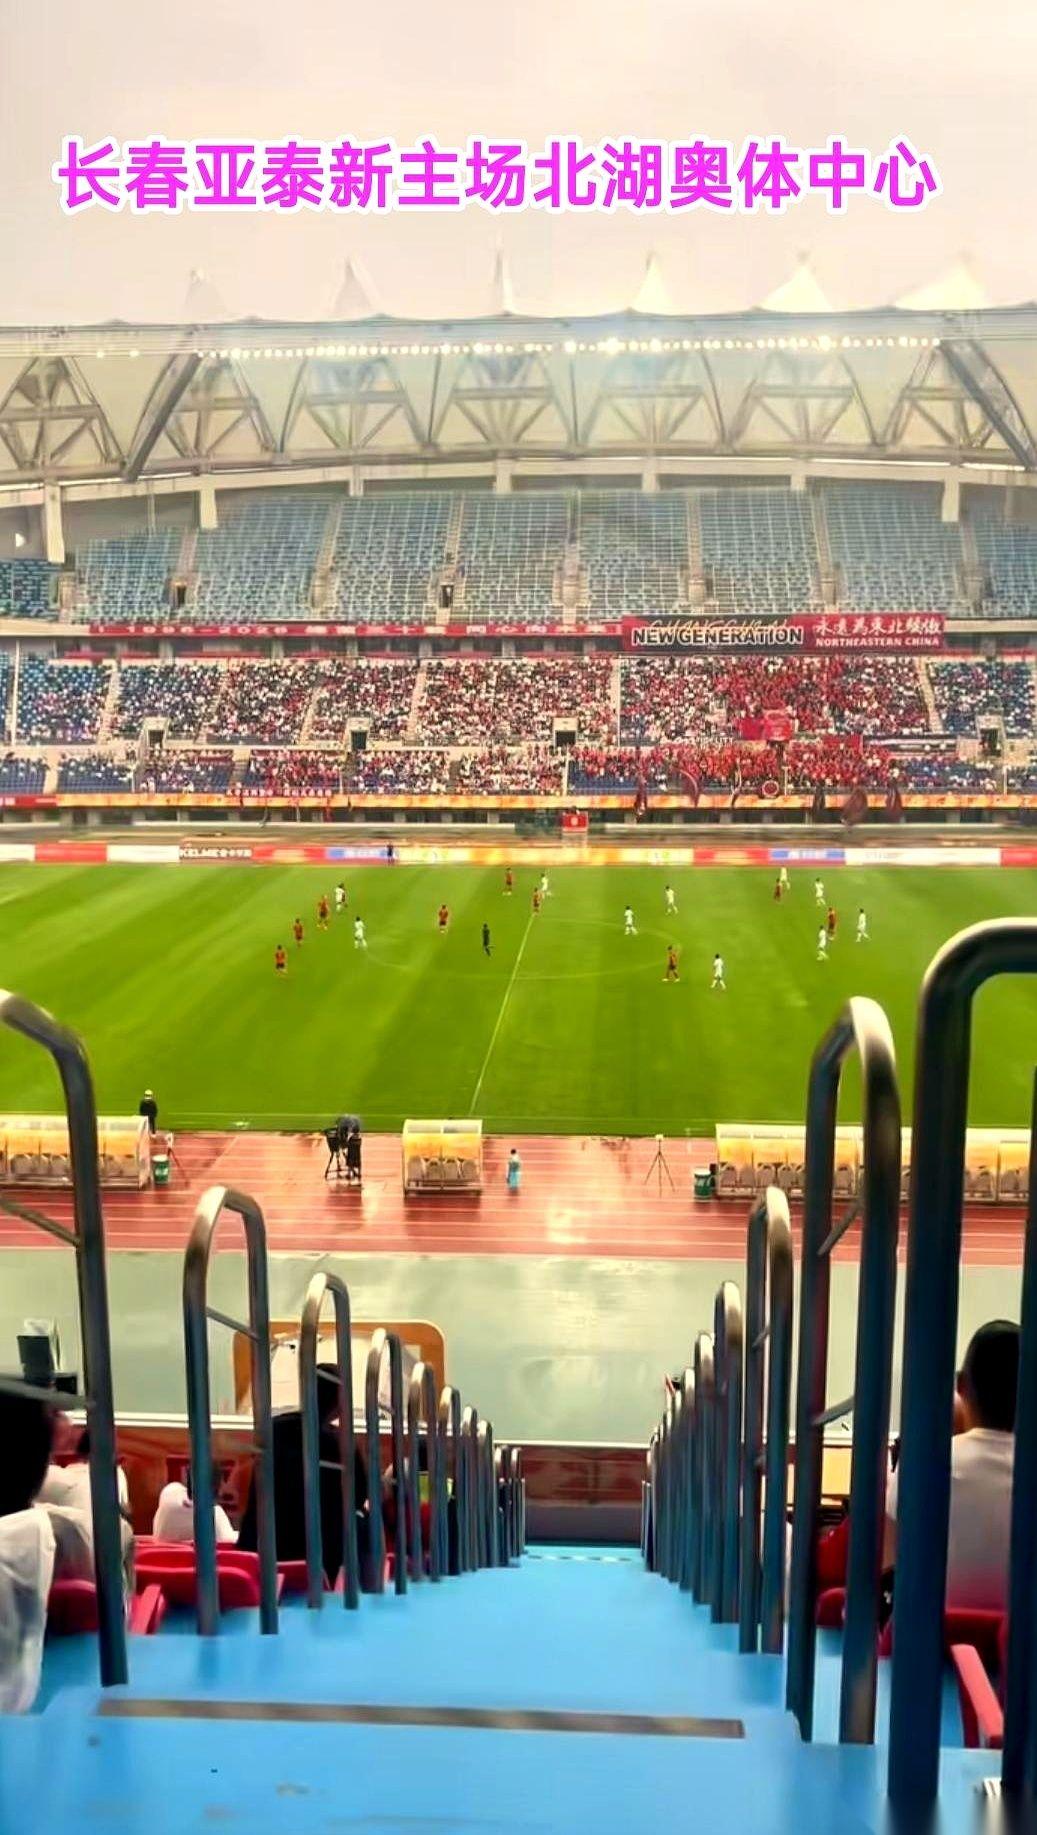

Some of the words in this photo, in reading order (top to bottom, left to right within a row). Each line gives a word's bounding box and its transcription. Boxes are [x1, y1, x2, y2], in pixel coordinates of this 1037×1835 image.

[631, 626, 676, 646] NEW
[678, 626, 804, 646] GENERATION
[815, 637, 902, 647] NORTHEASTERN
[904, 637, 940, 647] CHINA
